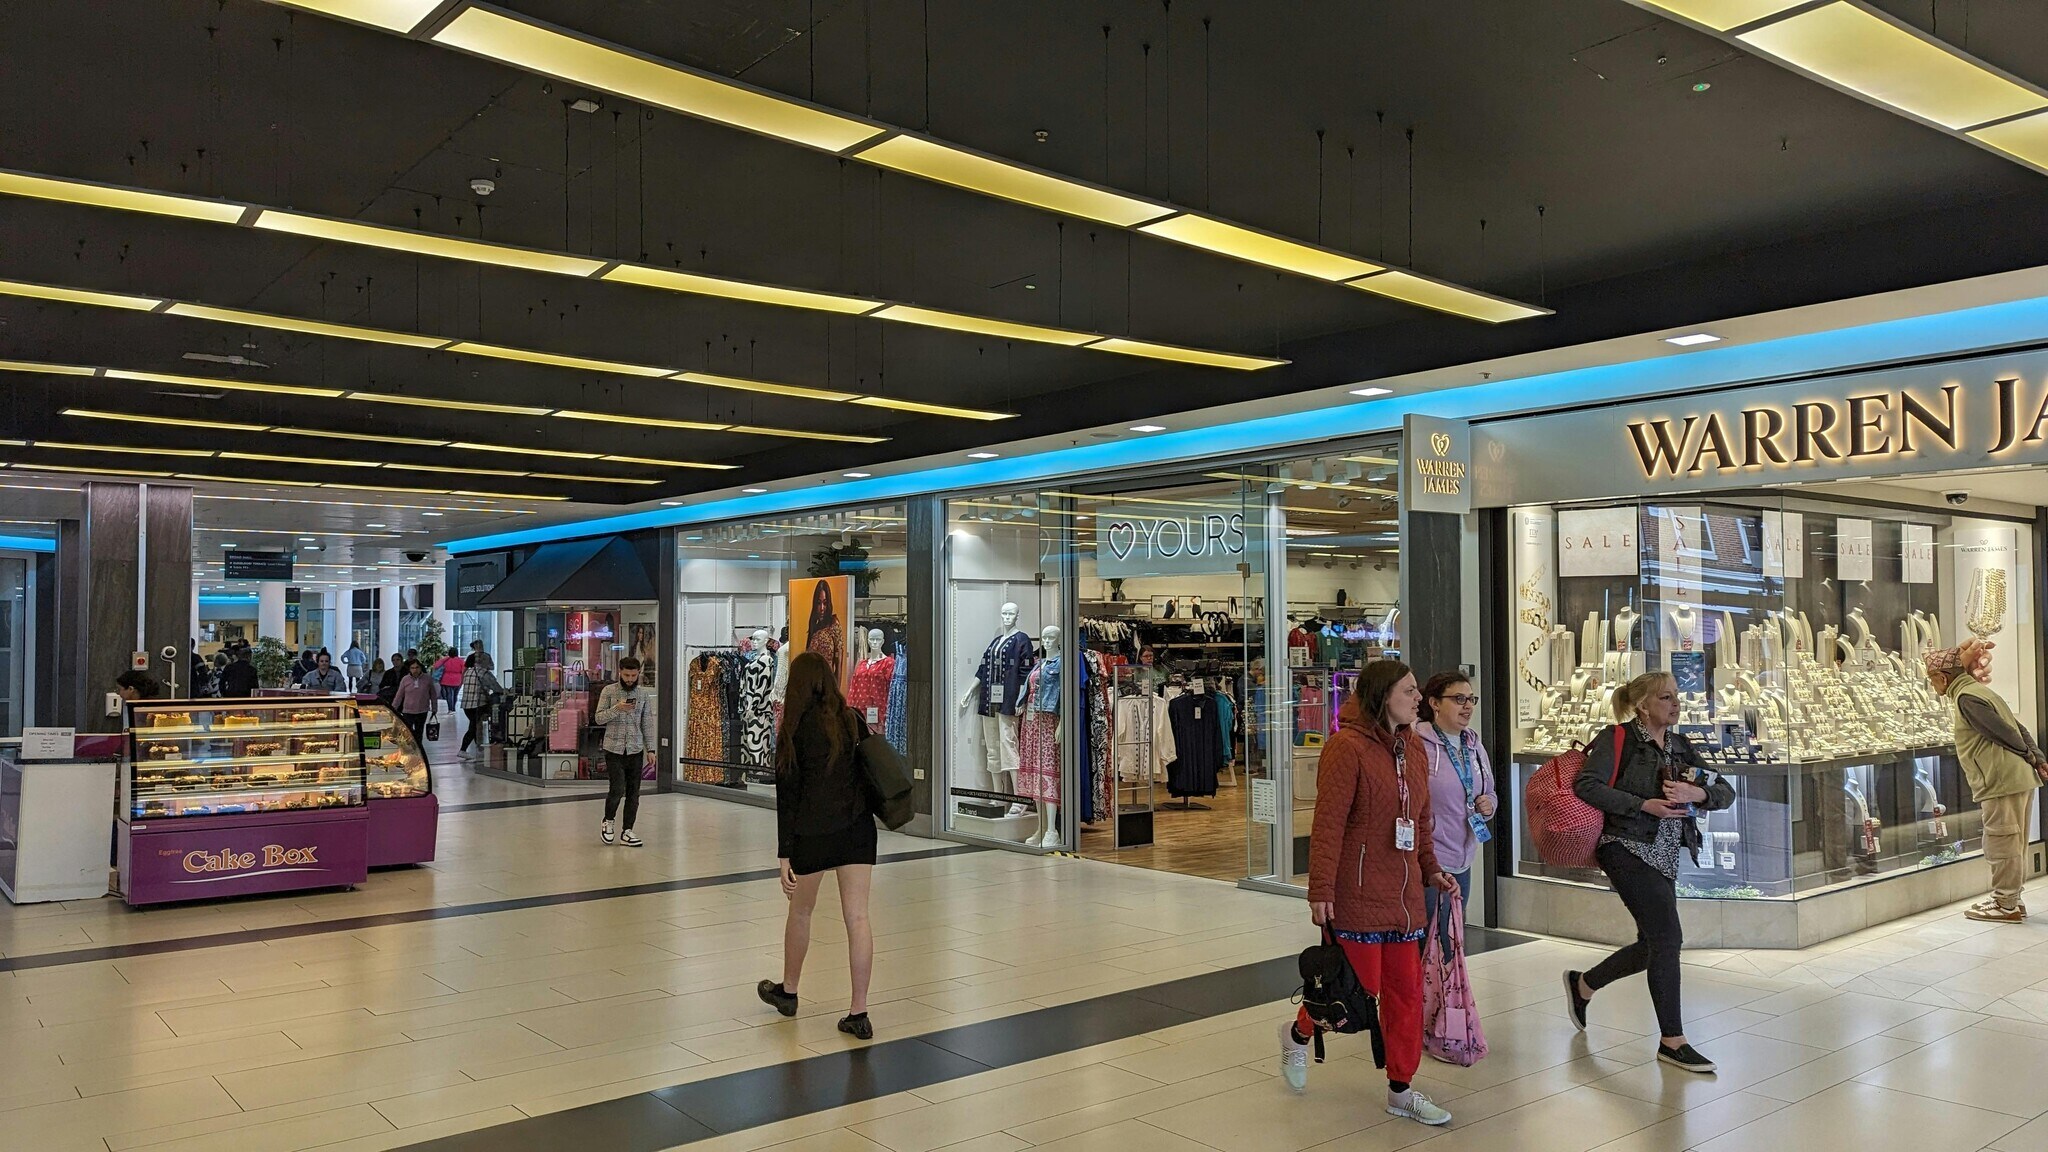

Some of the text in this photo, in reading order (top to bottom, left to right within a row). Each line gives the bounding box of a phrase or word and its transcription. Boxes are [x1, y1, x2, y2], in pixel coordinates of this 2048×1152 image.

[1626, 384, 1960, 477] WARREN
[1416, 458, 1465, 478] WARREN
[1423, 477, 1460, 495] JAMES
[1138, 513, 1244, 559] YOURS
[1565, 534, 1631, 550] SALE
[1766, 538, 1801, 552] SALE
[1840, 542, 1871, 556] SALE
[1904, 548, 1932, 560] SALE
[158, 848, 183, 857] Eggfree
[183, 844, 318, 873] Cake Box
